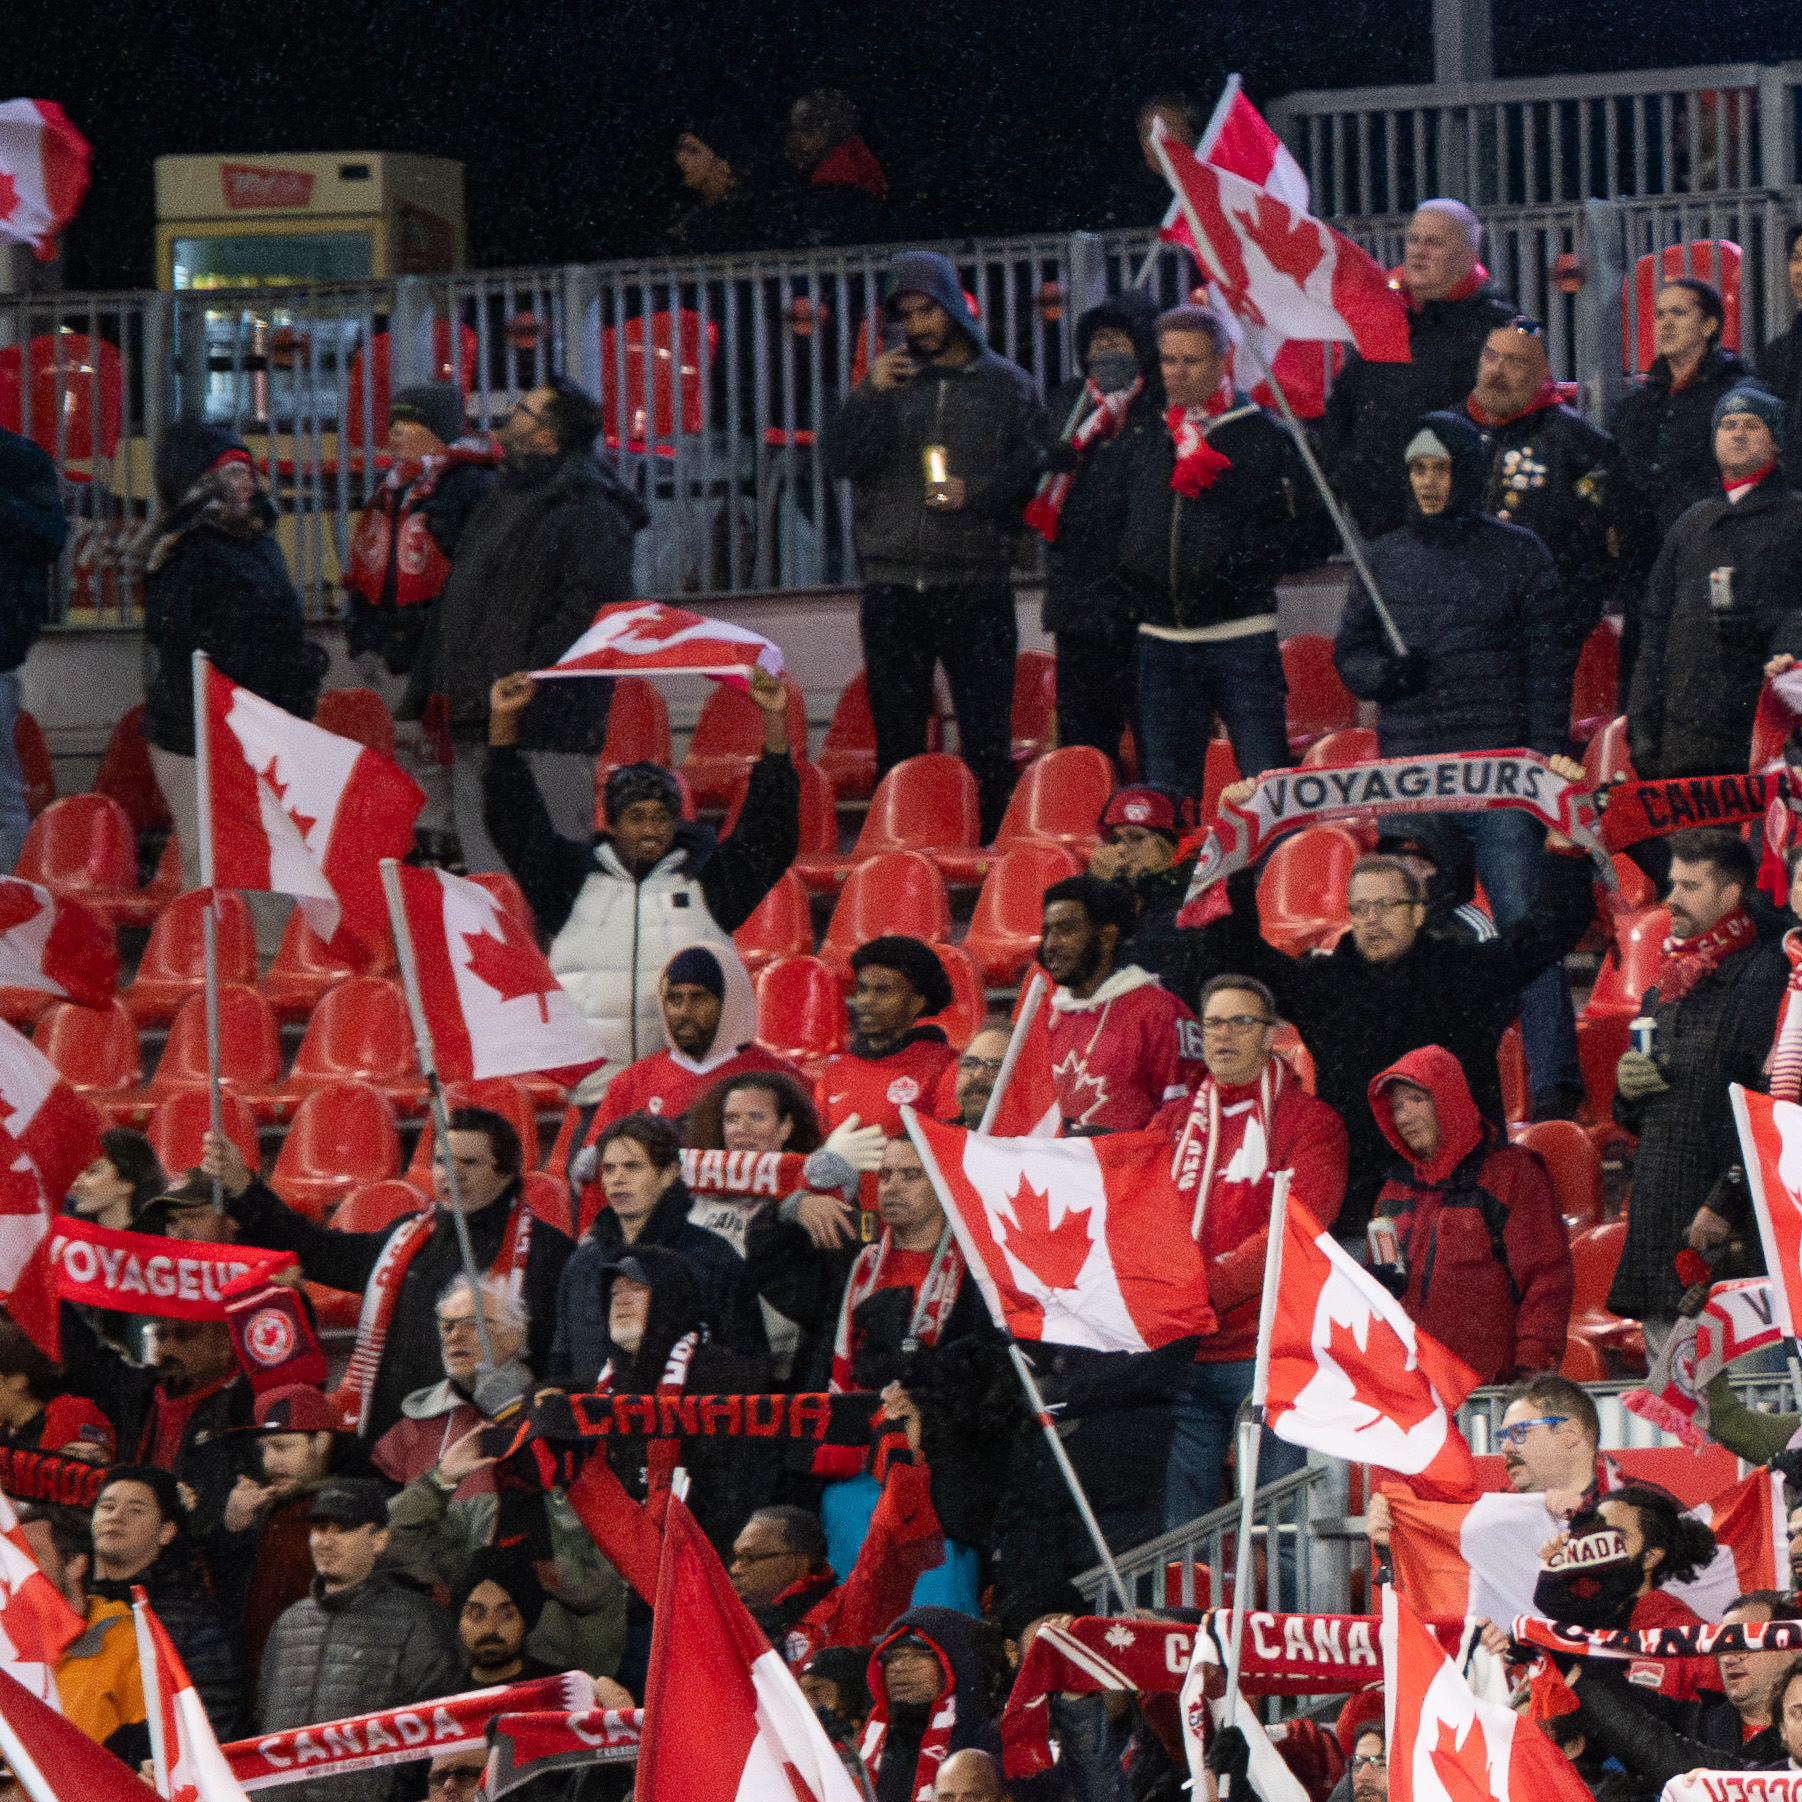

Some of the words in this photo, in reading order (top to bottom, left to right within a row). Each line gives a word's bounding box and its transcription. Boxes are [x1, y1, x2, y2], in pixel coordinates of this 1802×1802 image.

[1262, 756, 1546, 817] VOYAGEURS
[1636, 774, 1784, 828] CANAD
[680, 1148, 779, 1196] NADA
[571, 1391, 831, 1439] CANADA
[1547, 1533, 1628, 1569] CNADA
[1243, 1612, 1384, 1666] CANA
[257, 1707, 464, 1769] CANADA
